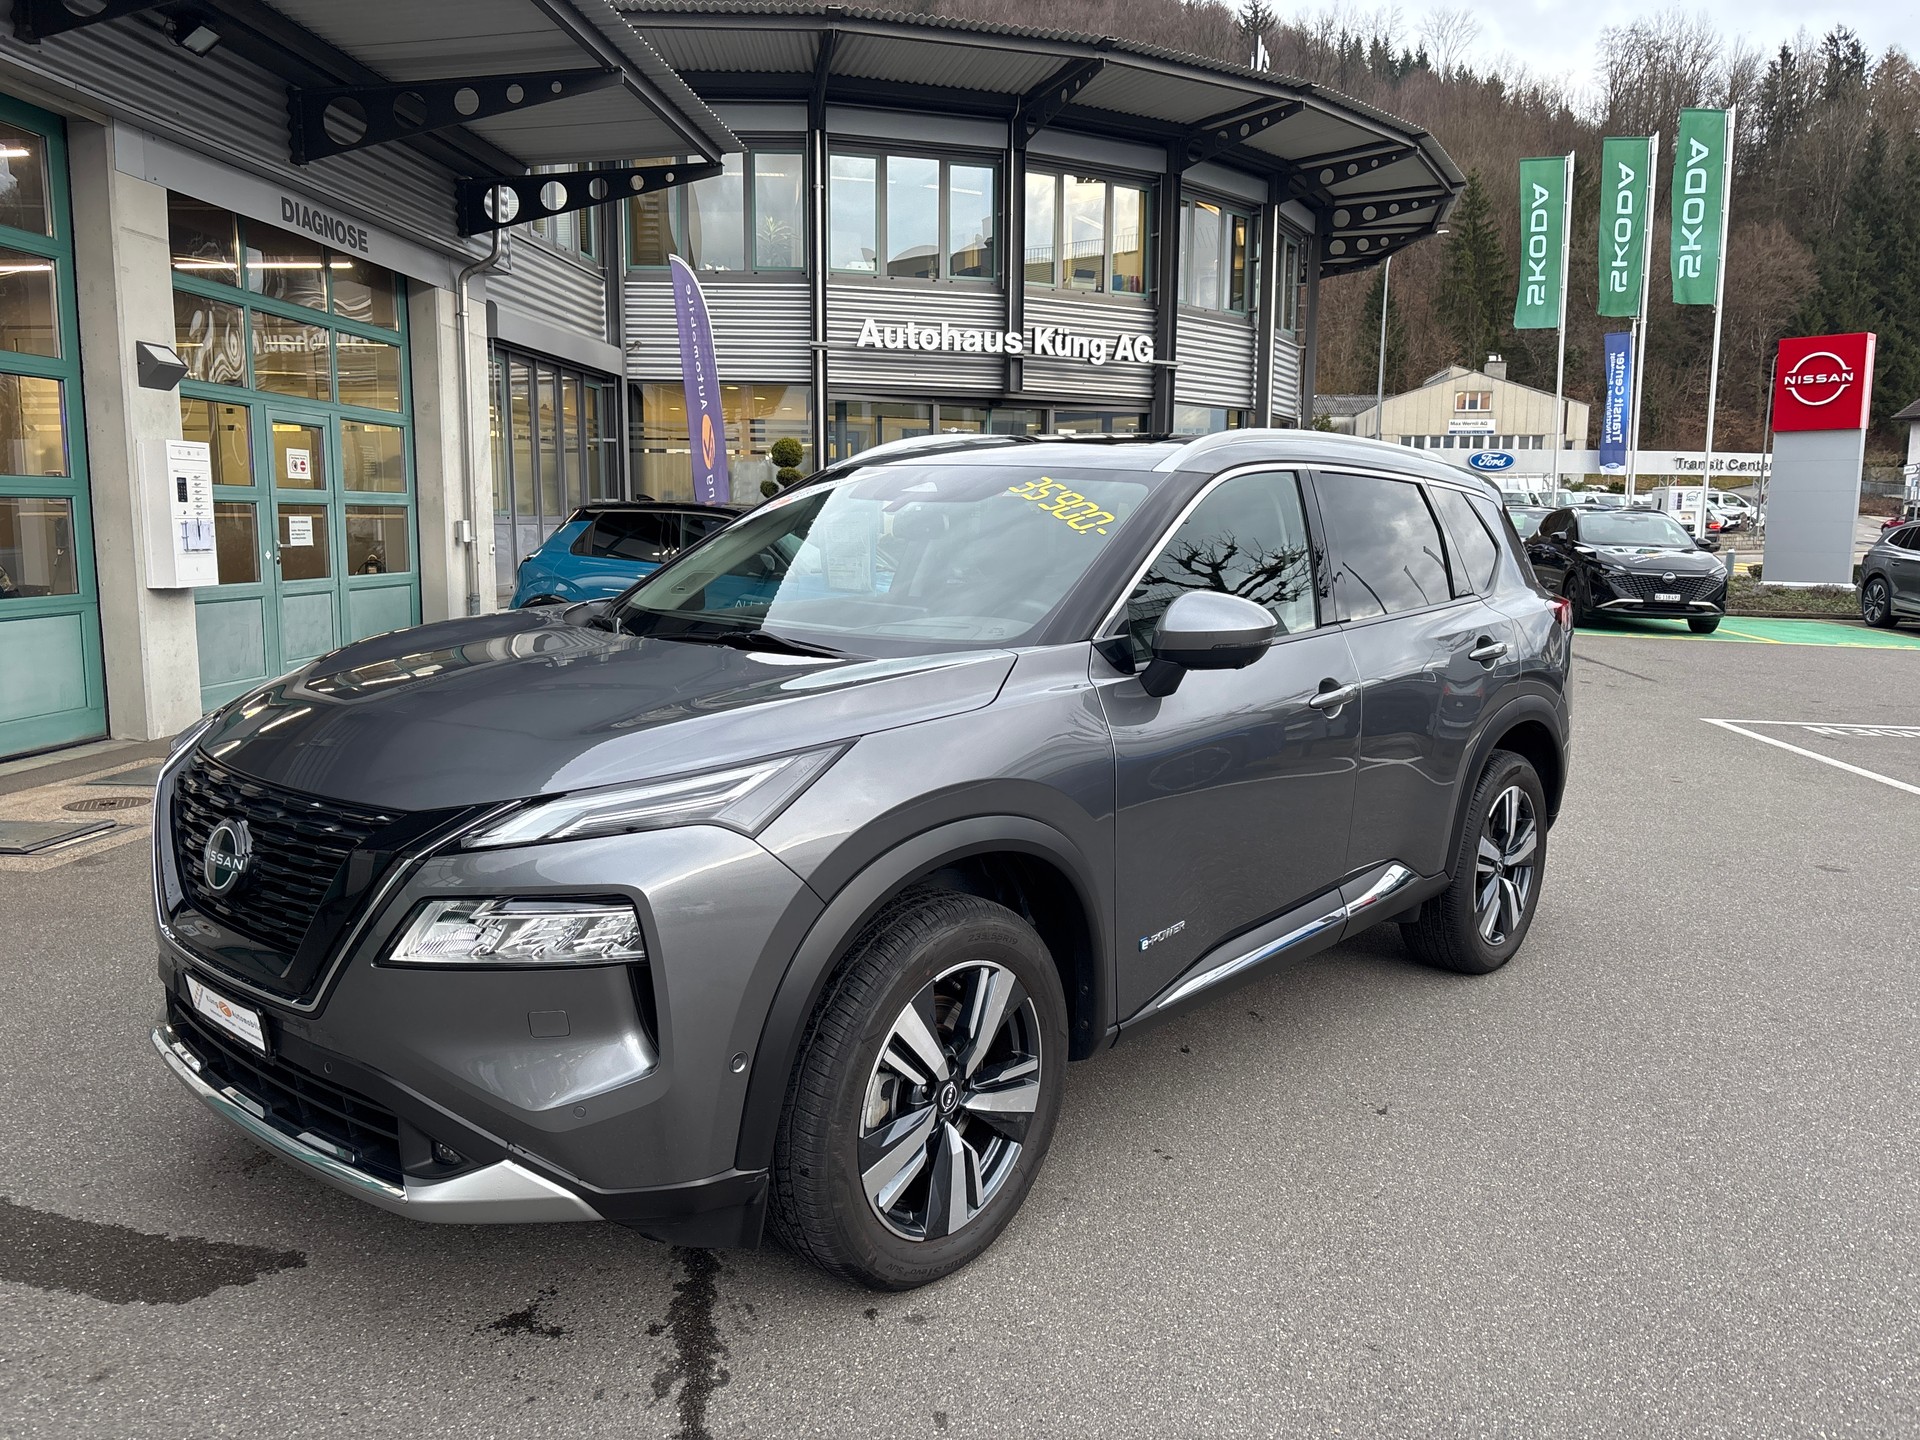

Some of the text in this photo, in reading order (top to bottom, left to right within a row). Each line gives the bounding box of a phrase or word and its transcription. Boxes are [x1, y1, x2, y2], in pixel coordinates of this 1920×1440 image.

[281, 196, 369, 253] DIAGNOSE
[857, 318, 1154, 365] Autohaus Küng AG
[1784, 372, 1854, 385] NISSAN
[1477, 453, 1507, 467] Ford
[1676, 457, 1724, 470] Transit
